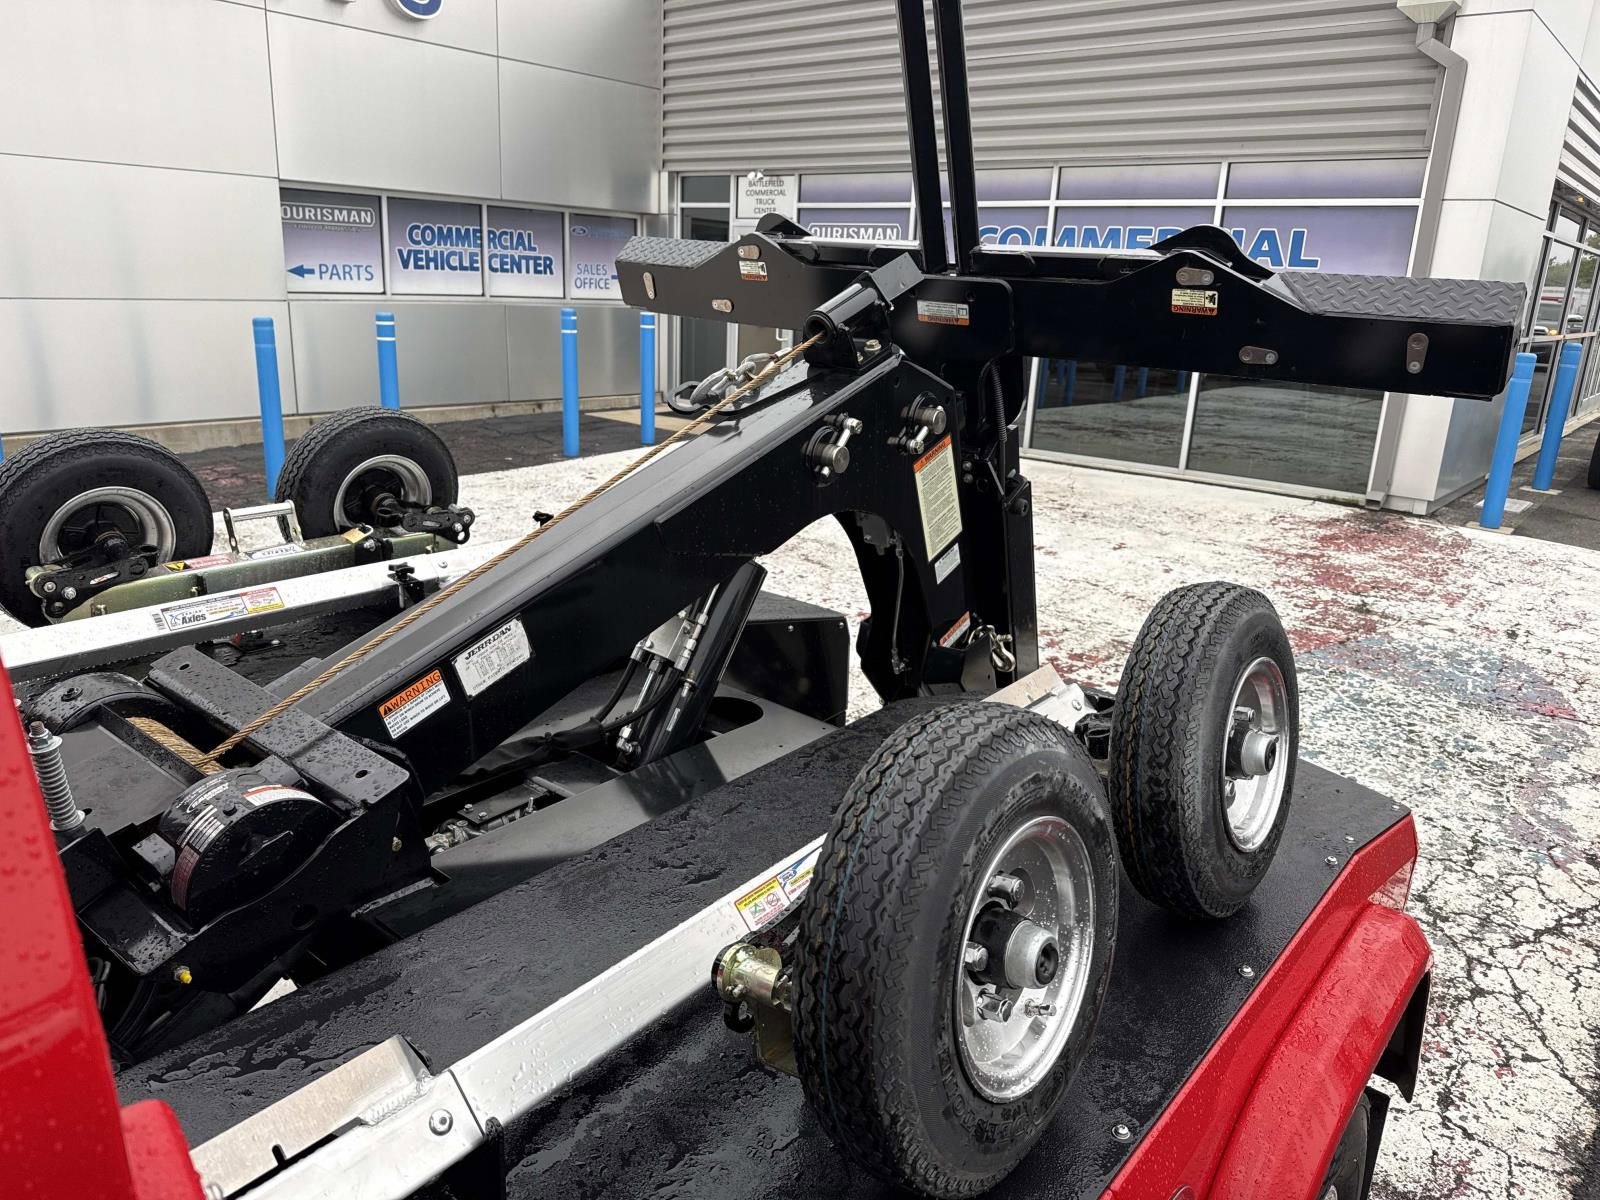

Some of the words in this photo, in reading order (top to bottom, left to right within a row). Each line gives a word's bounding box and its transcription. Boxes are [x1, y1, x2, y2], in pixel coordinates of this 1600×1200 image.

[748, 179, 785, 188] BATTLEFIELD
[746, 189, 787, 197] COMMERCIAL
[755, 198, 775, 206] TRUCK
[281, 205, 372, 224] OURISMAN
[406, 223, 537, 252] COMMERCIAL
[811, 226, 898, 240] OURISMAN
[397, 248, 481, 273] VEHICLE
[488, 252, 555, 276] CENTER
[318, 263, 375, 282] PARTS
[576, 263, 608, 276] SALES
[574, 277, 611, 290] OFFICE
[181, 612, 207, 625] Axles
[390, 671, 441, 711] WARNING
